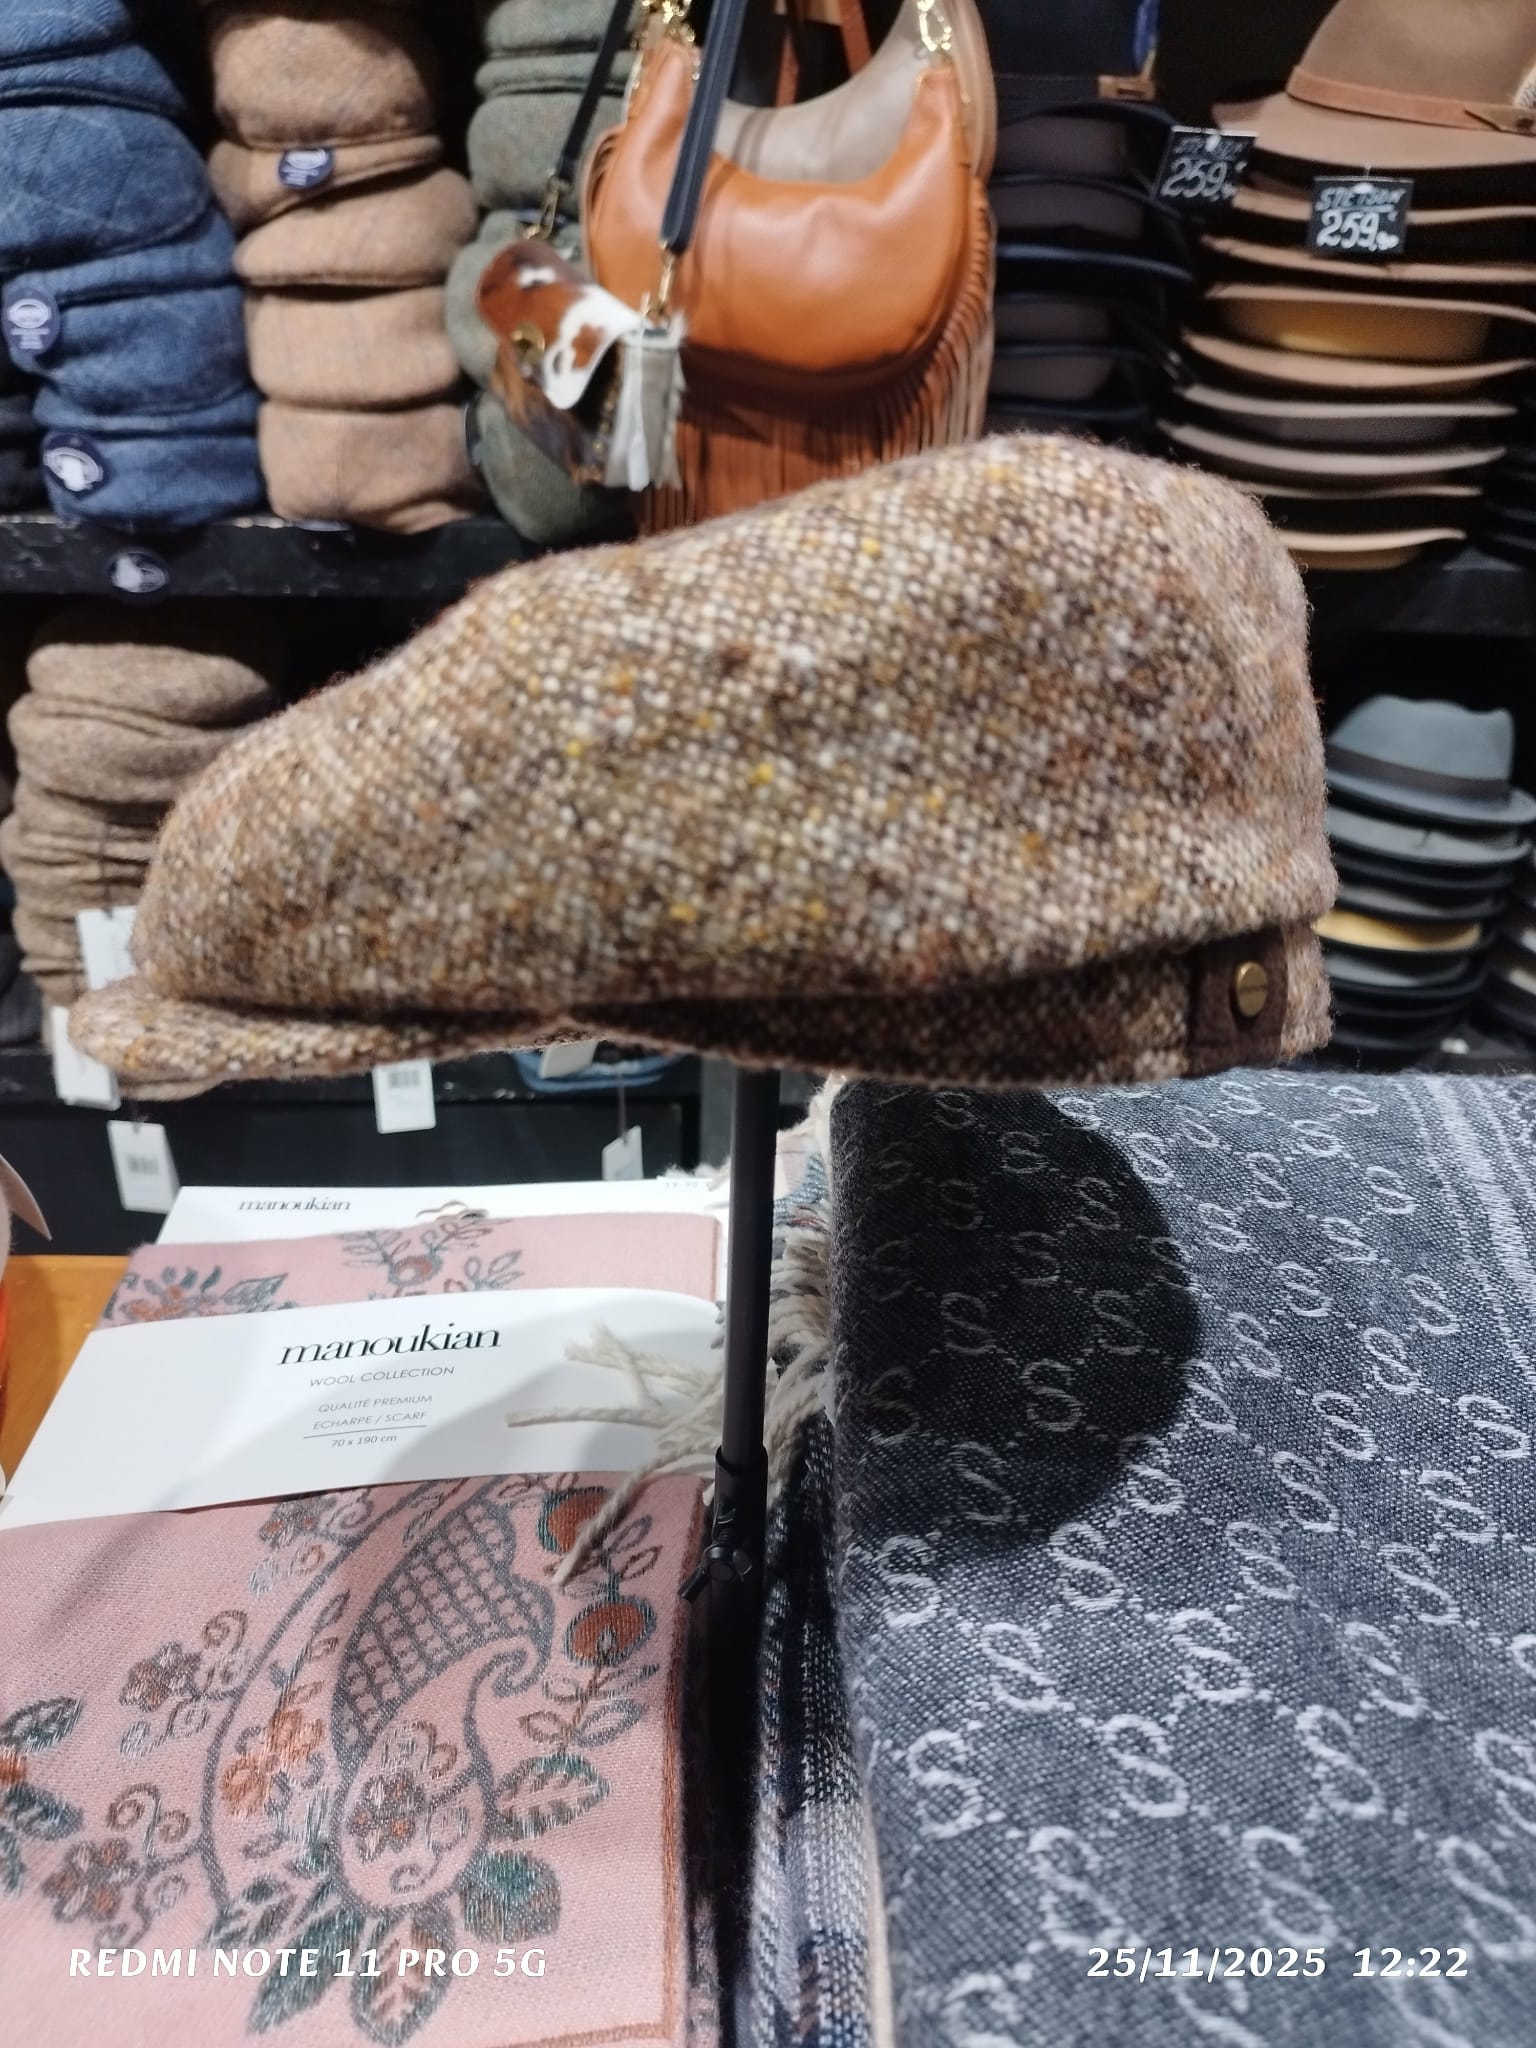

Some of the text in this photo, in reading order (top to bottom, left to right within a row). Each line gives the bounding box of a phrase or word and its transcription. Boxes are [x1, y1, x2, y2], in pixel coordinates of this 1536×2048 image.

[277, 1323, 502, 1365] manoukian
[309, 1366, 456, 1388] WOOL COLLECTION
[373, 1394, 433, 1408] PREMIUM
[312, 1415, 374, 1431] ECHARPE
[384, 1411, 428, 1423] SCARF
[331, 1438, 345, 1448] 70
[357, 1435, 378, 1446] 190
[380, 1434, 397, 1444] cm
